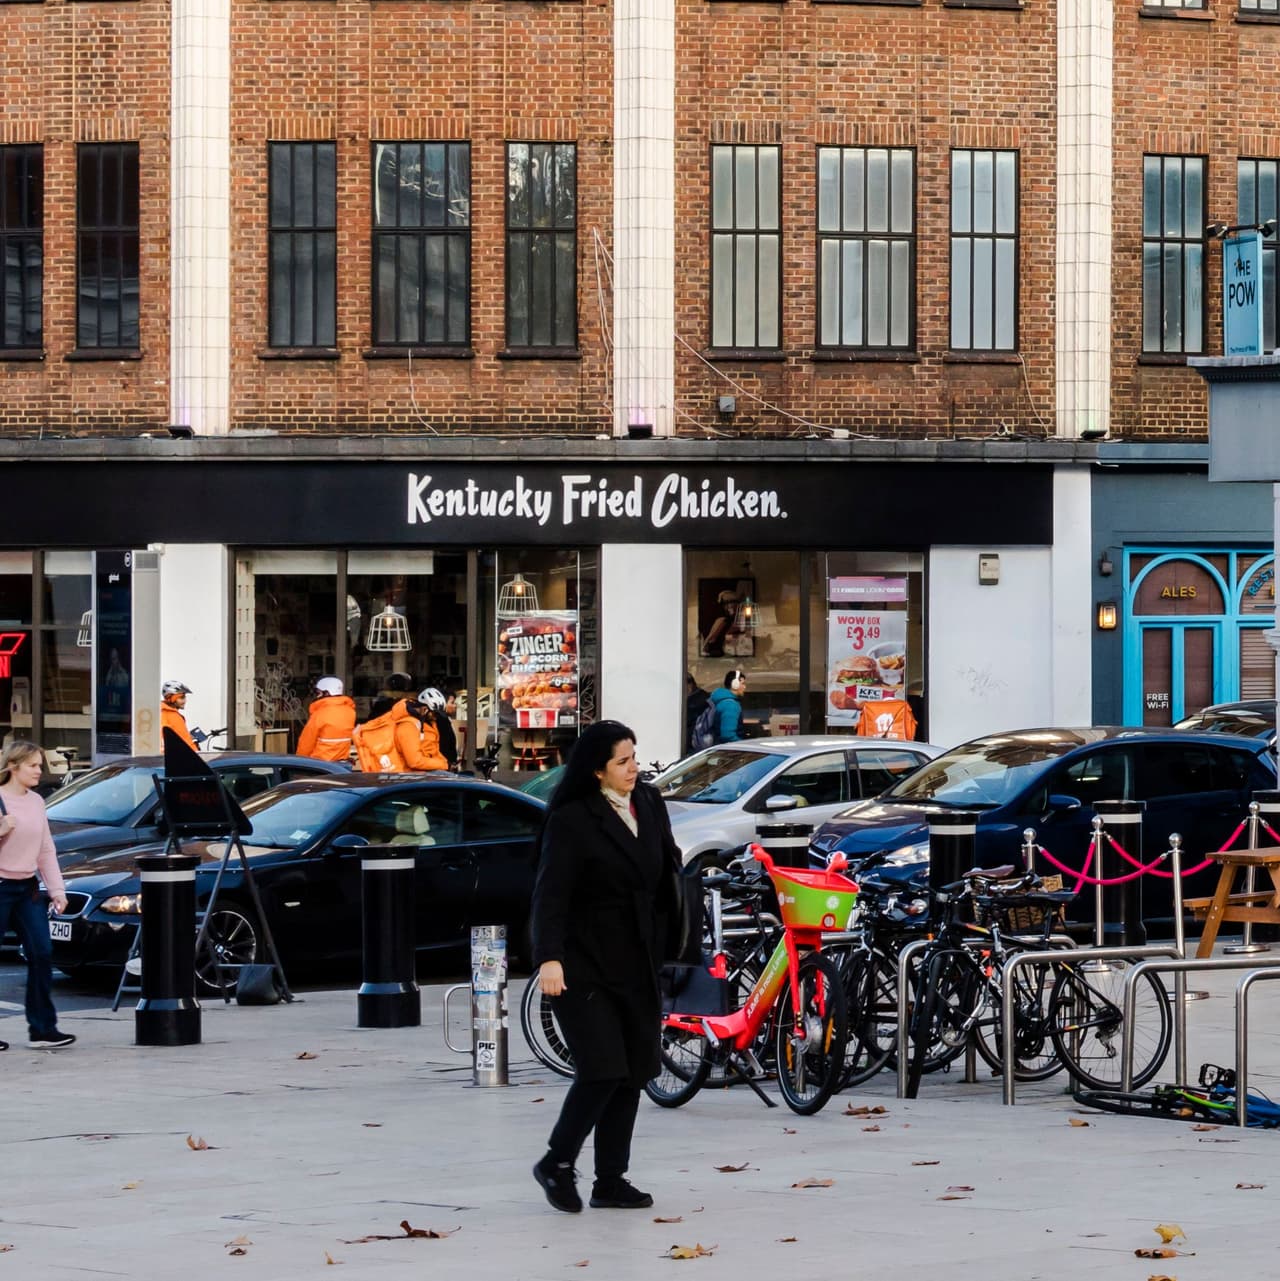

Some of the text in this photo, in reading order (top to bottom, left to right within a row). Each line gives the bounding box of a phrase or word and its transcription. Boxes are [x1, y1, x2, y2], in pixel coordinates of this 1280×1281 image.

[1229, 280, 1255, 309] POW
[407, 473, 551, 525] Kentucky
[562, 475, 642, 525] Fried
[1162, 587, 1197, 598] ALES
[838, 616, 865, 625] WOW
[510, 633, 563, 656] ZINGER
[847, 626, 880, 650] £3.49
[859, 688, 881, 696] KFC
[1146, 693, 1168, 701] FREE
